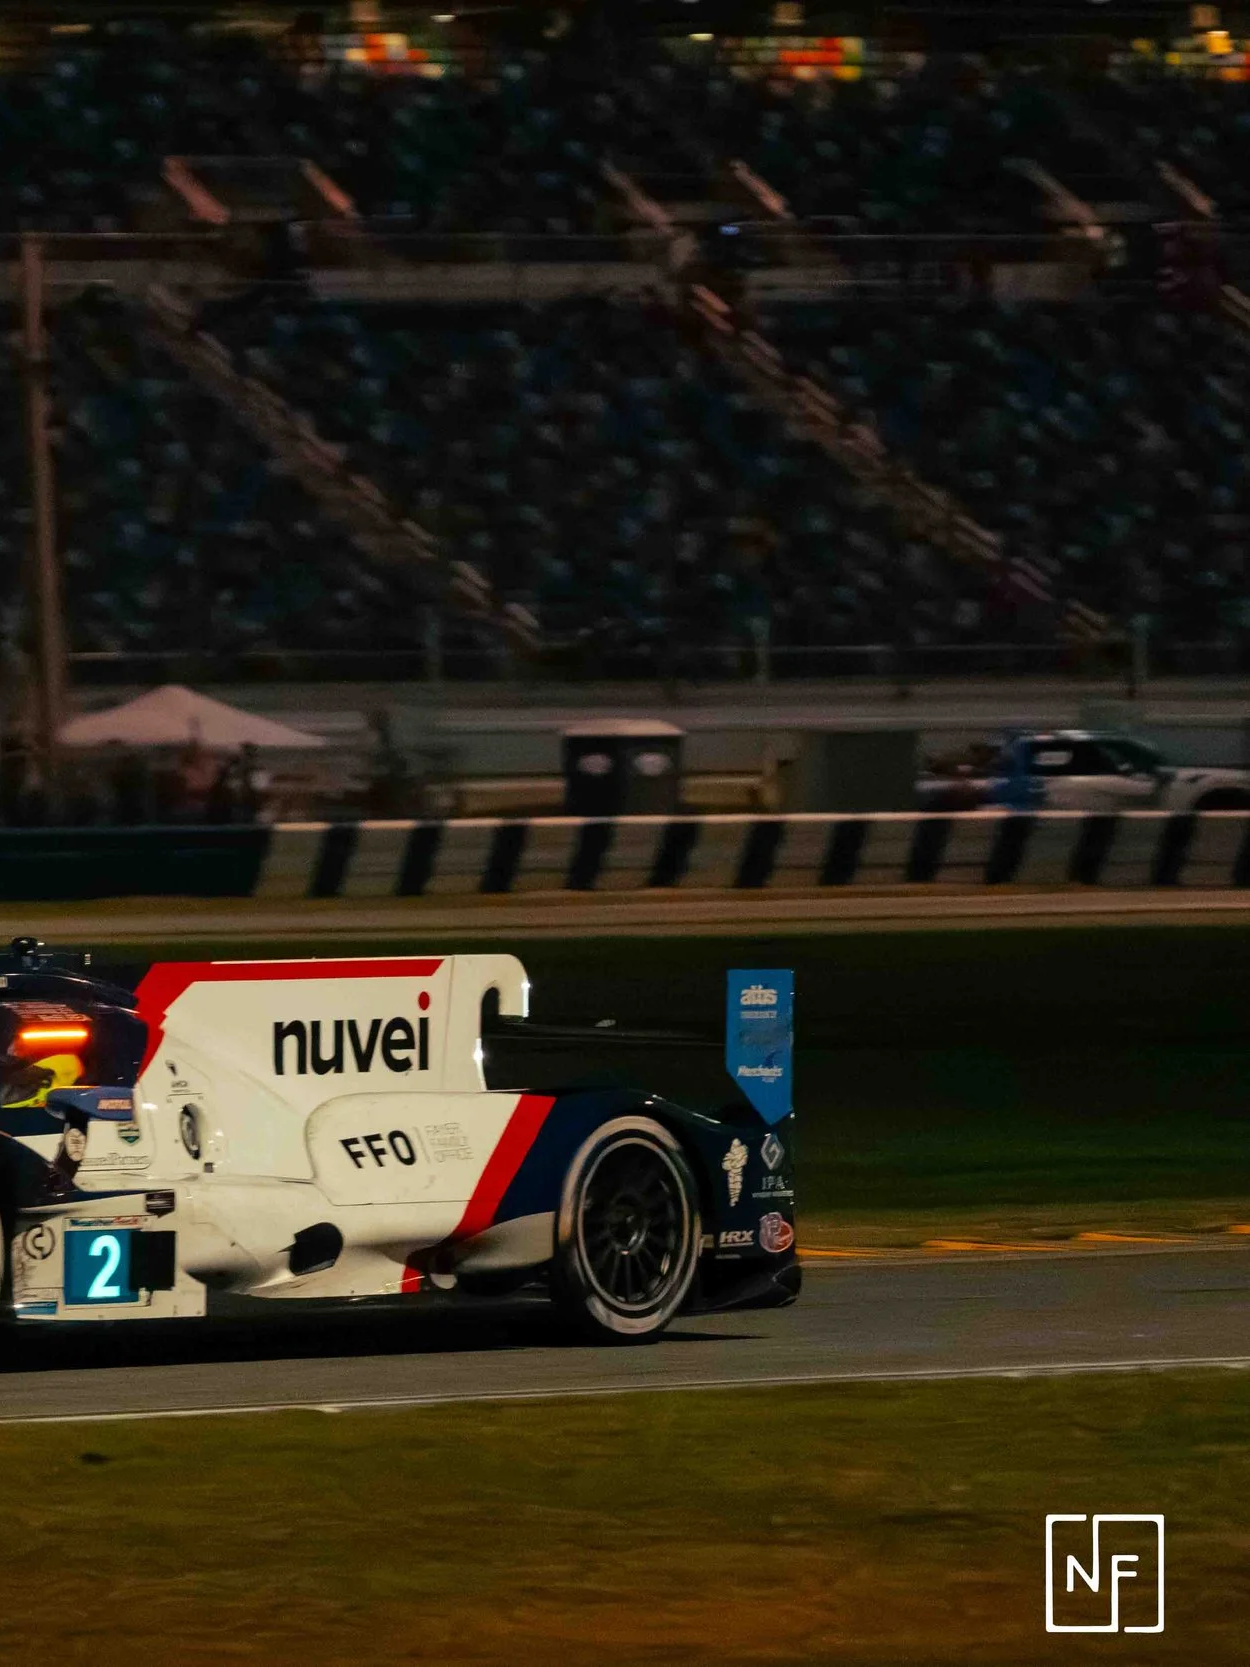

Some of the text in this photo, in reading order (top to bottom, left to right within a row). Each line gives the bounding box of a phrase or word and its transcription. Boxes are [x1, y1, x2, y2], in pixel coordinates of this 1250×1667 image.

[273, 991, 431, 1075] nuvei
[340, 1129, 418, 1169] FFO
[719, 1230, 755, 1244] HRX
[87, 1235, 121, 1298] 2
